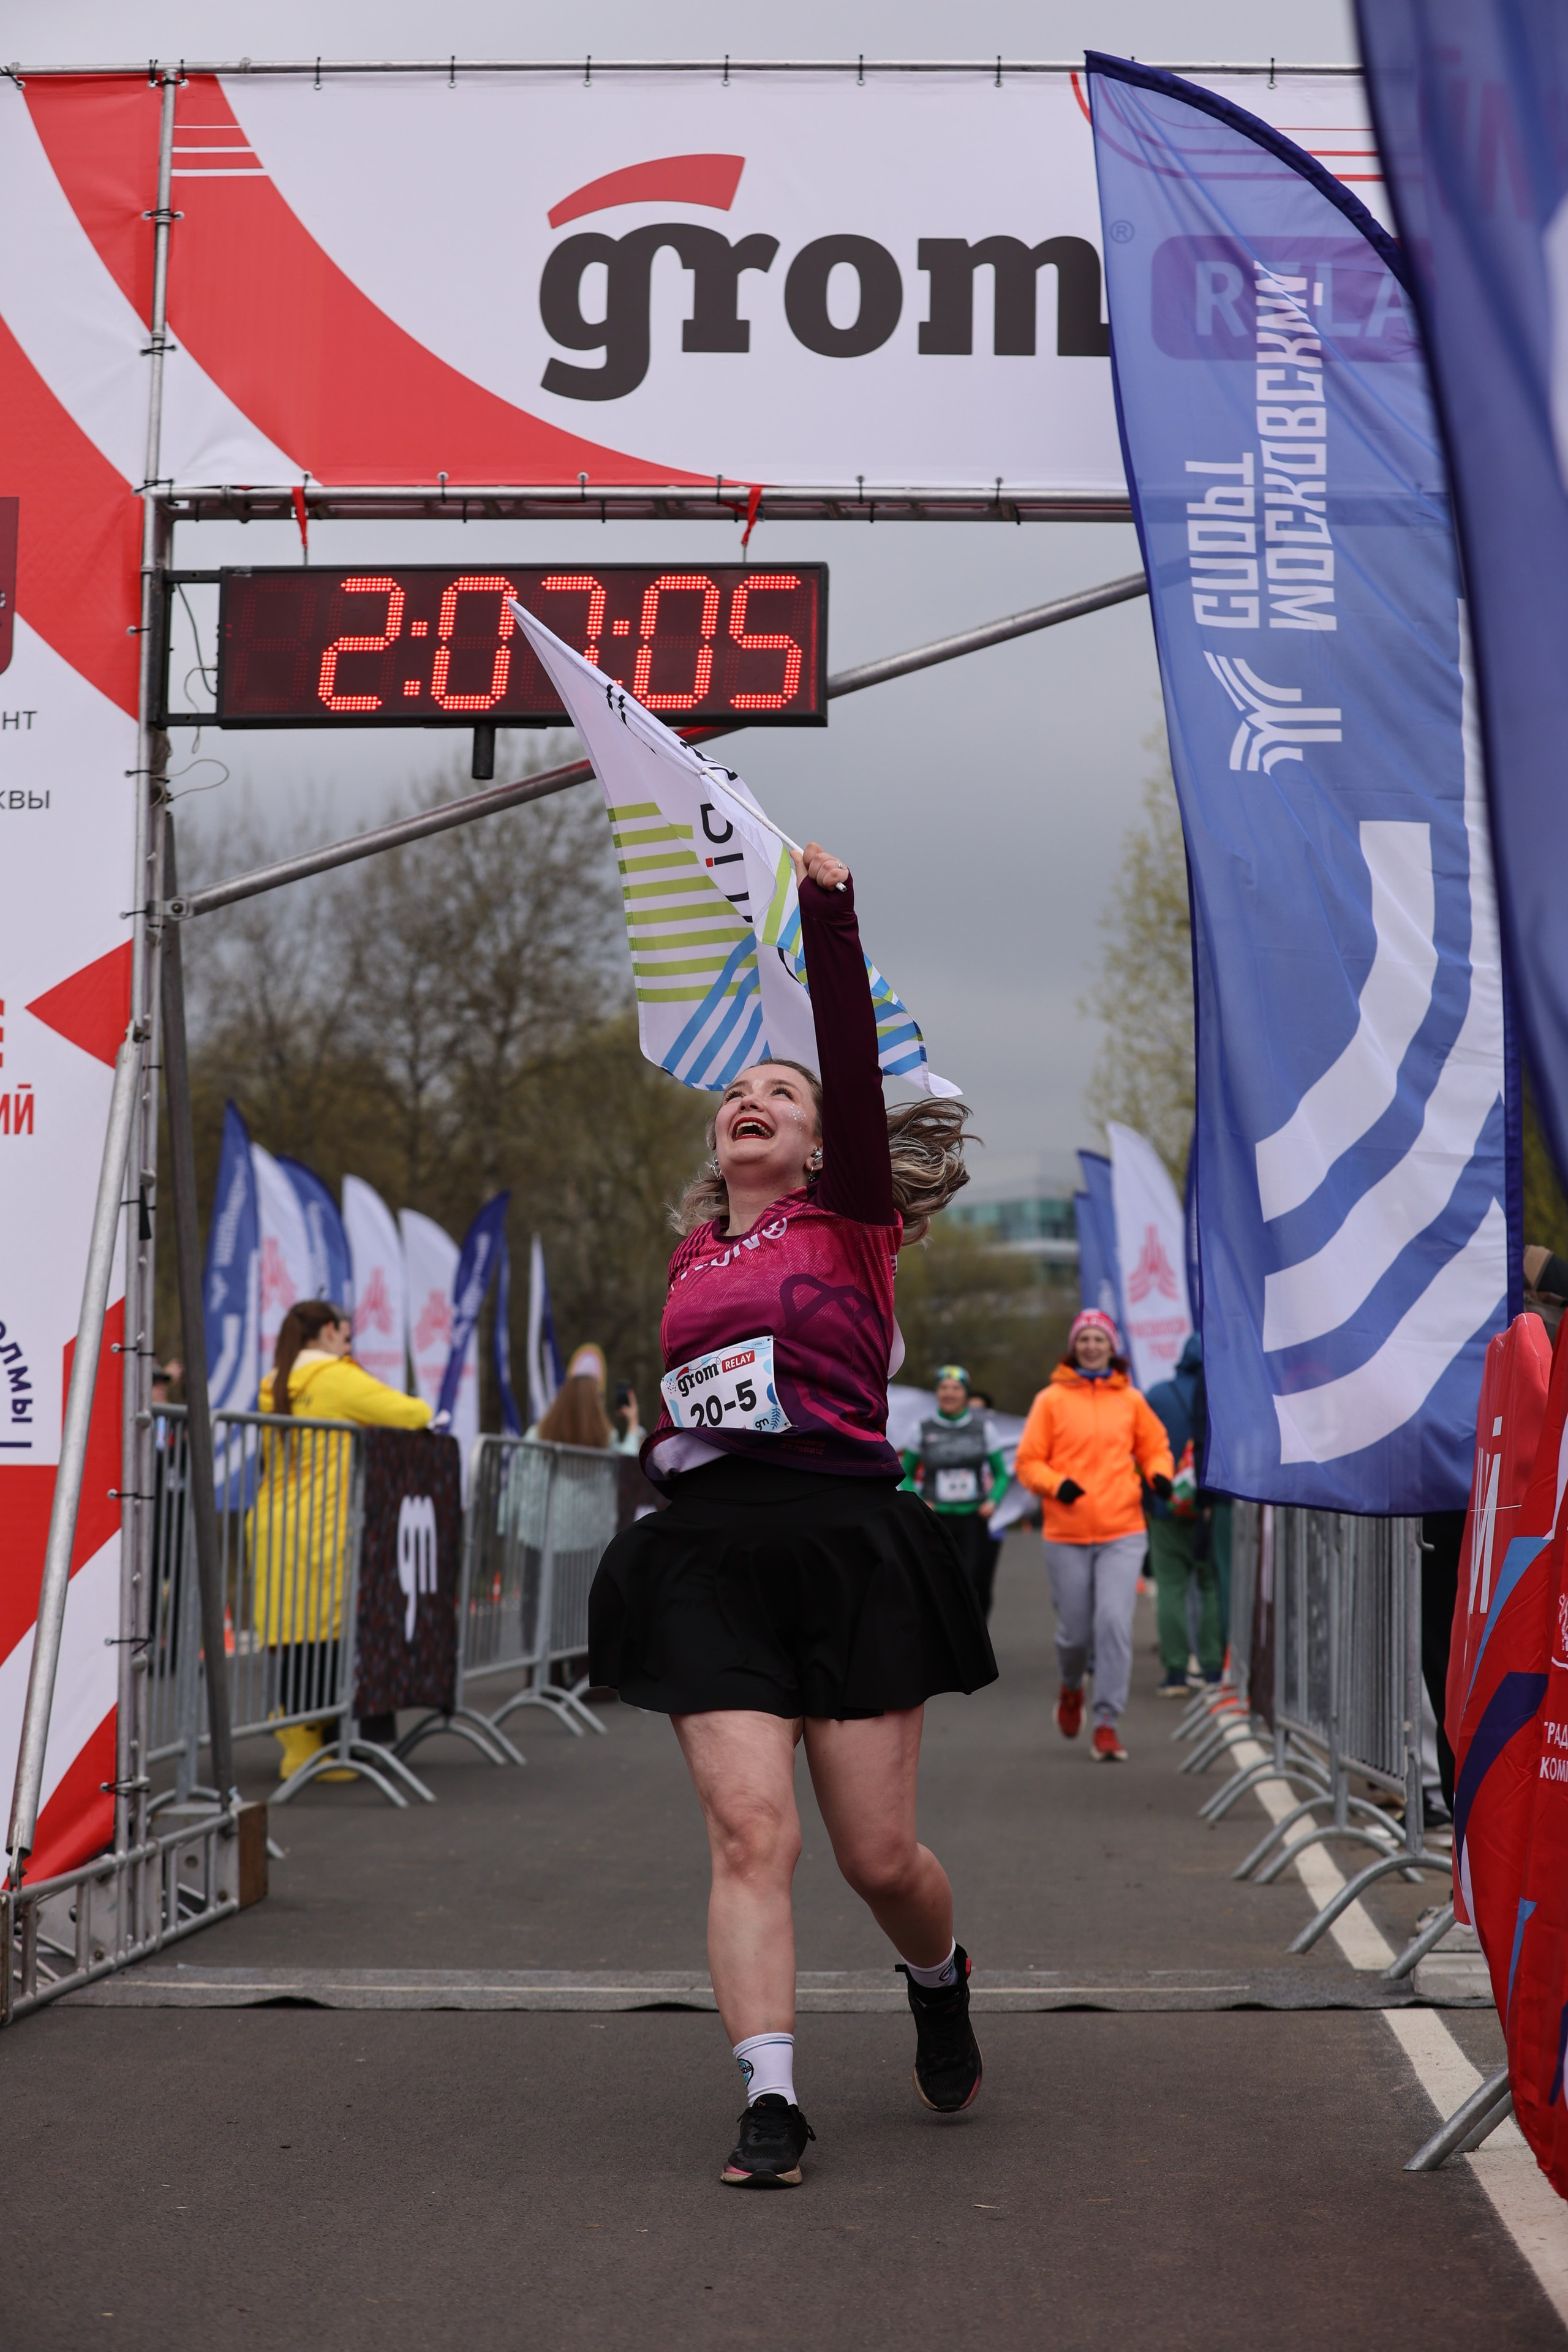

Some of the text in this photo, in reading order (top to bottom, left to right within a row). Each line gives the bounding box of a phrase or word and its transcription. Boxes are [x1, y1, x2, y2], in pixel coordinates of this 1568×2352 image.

[540, 222, 1109, 401] grom
[317, 576, 802, 710] 2:07:05
[677, 1352, 752, 1397] grom RELAY
[690, 1379, 757, 1427] 20-5
[1539, 1756, 1568, 1782] КОМ
